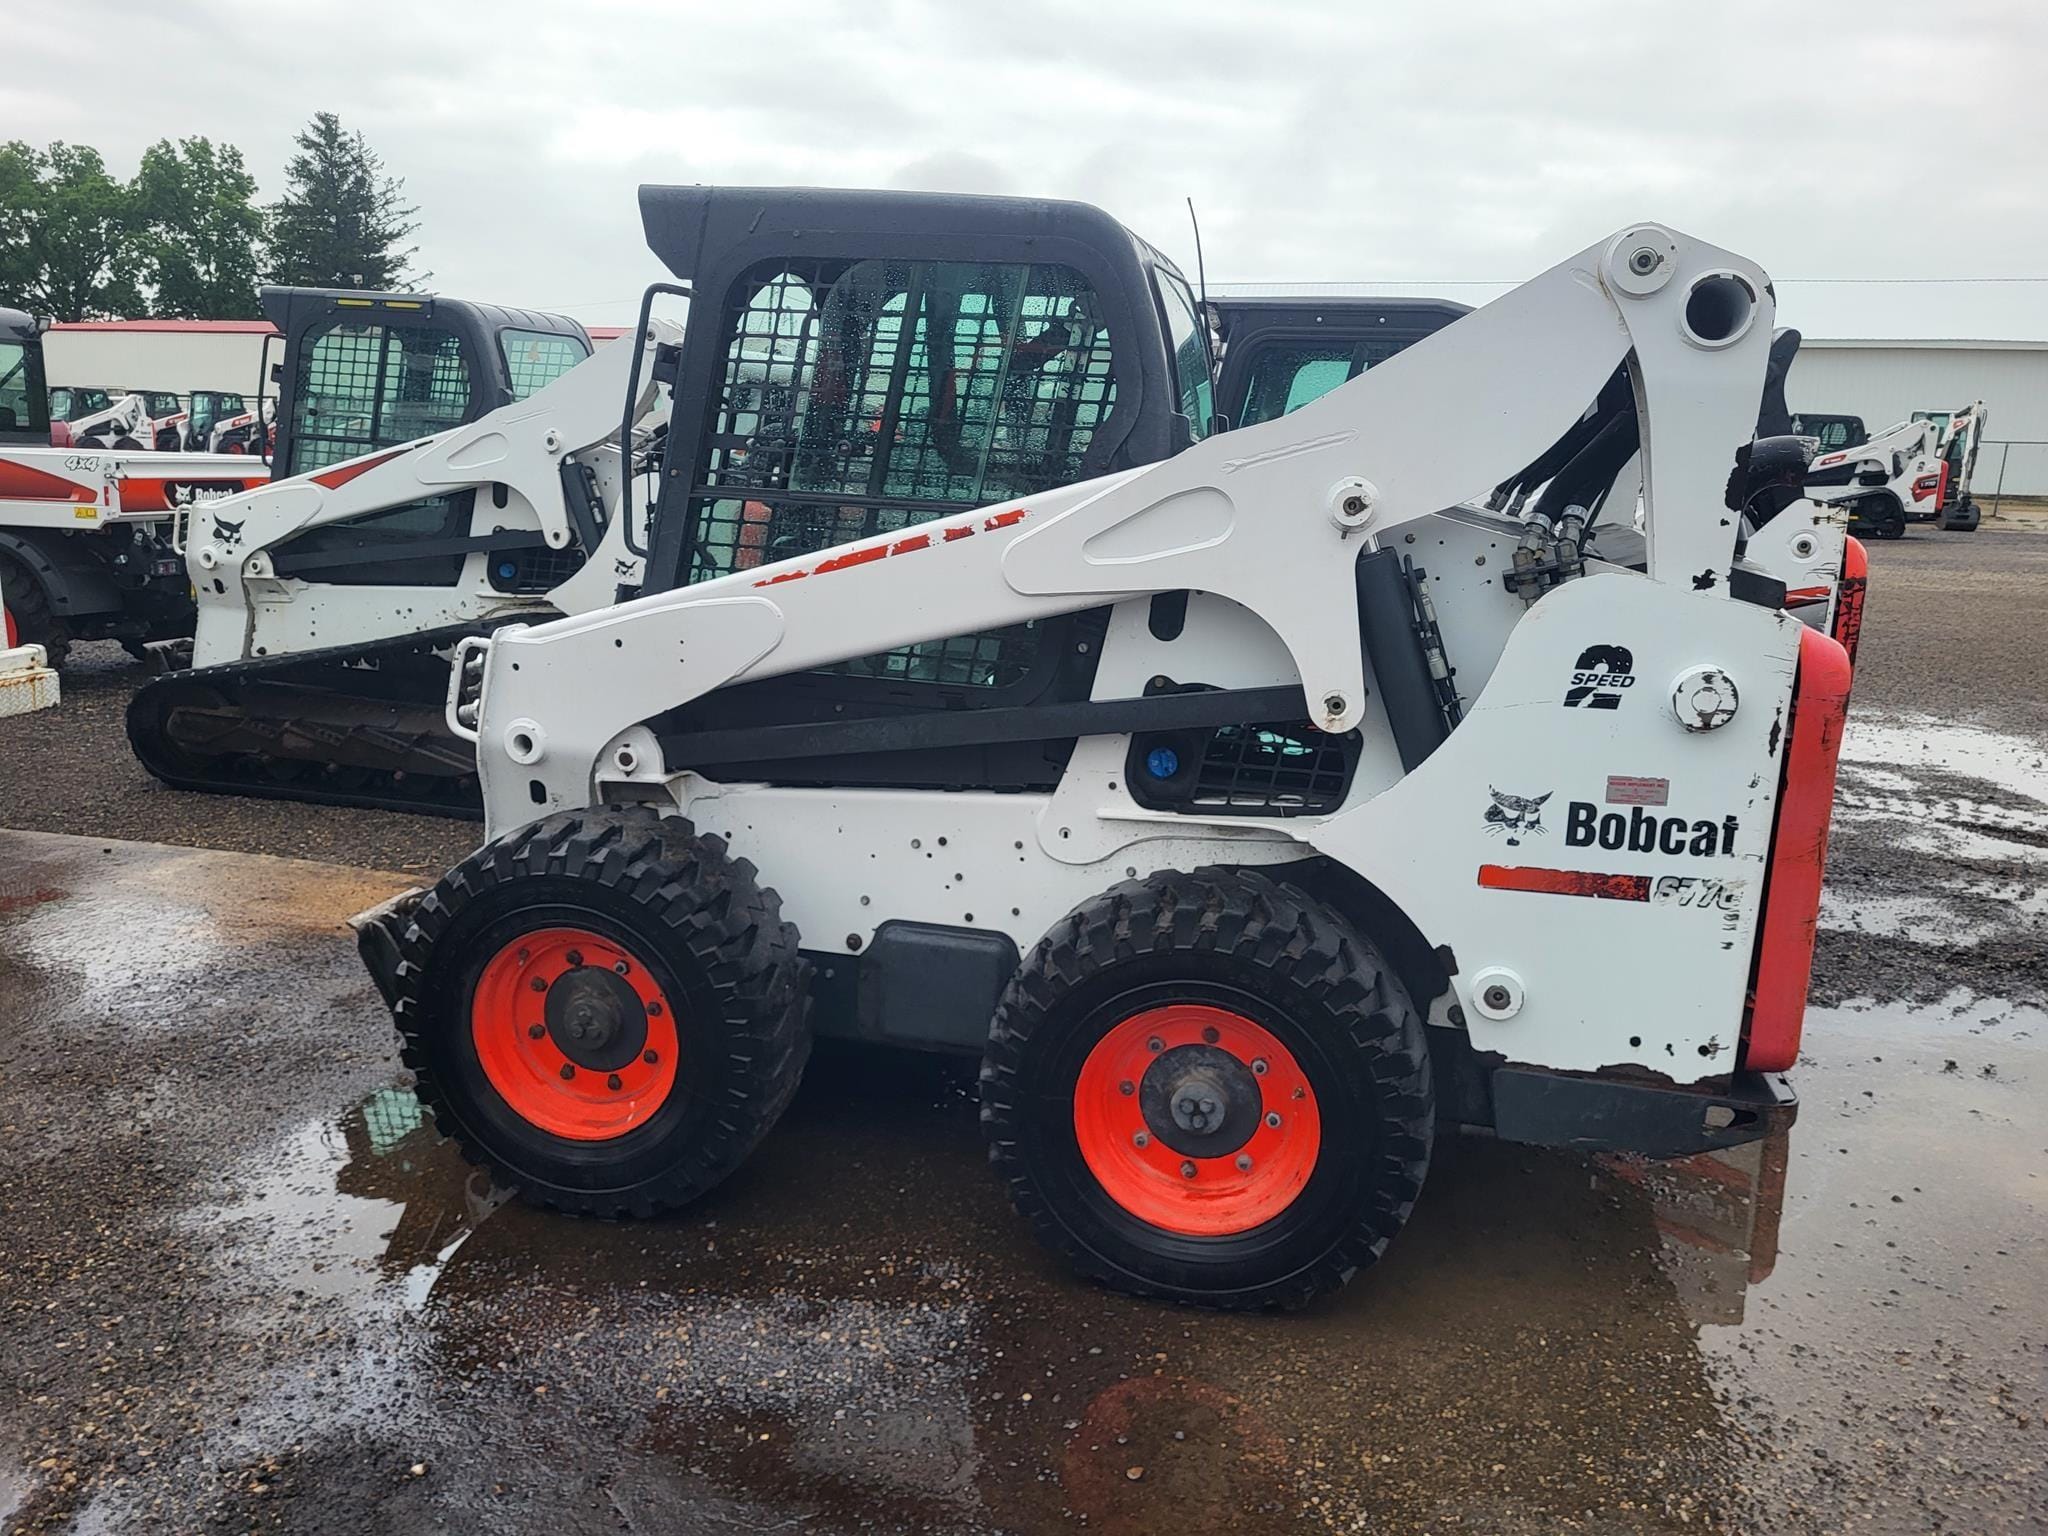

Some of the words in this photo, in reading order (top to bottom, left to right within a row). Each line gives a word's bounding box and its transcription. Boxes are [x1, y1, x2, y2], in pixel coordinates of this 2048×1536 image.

[65, 455, 100, 472] 4x4
[1571, 672, 1635, 688] SPEED
[1565, 801, 1739, 857] Bobcat
